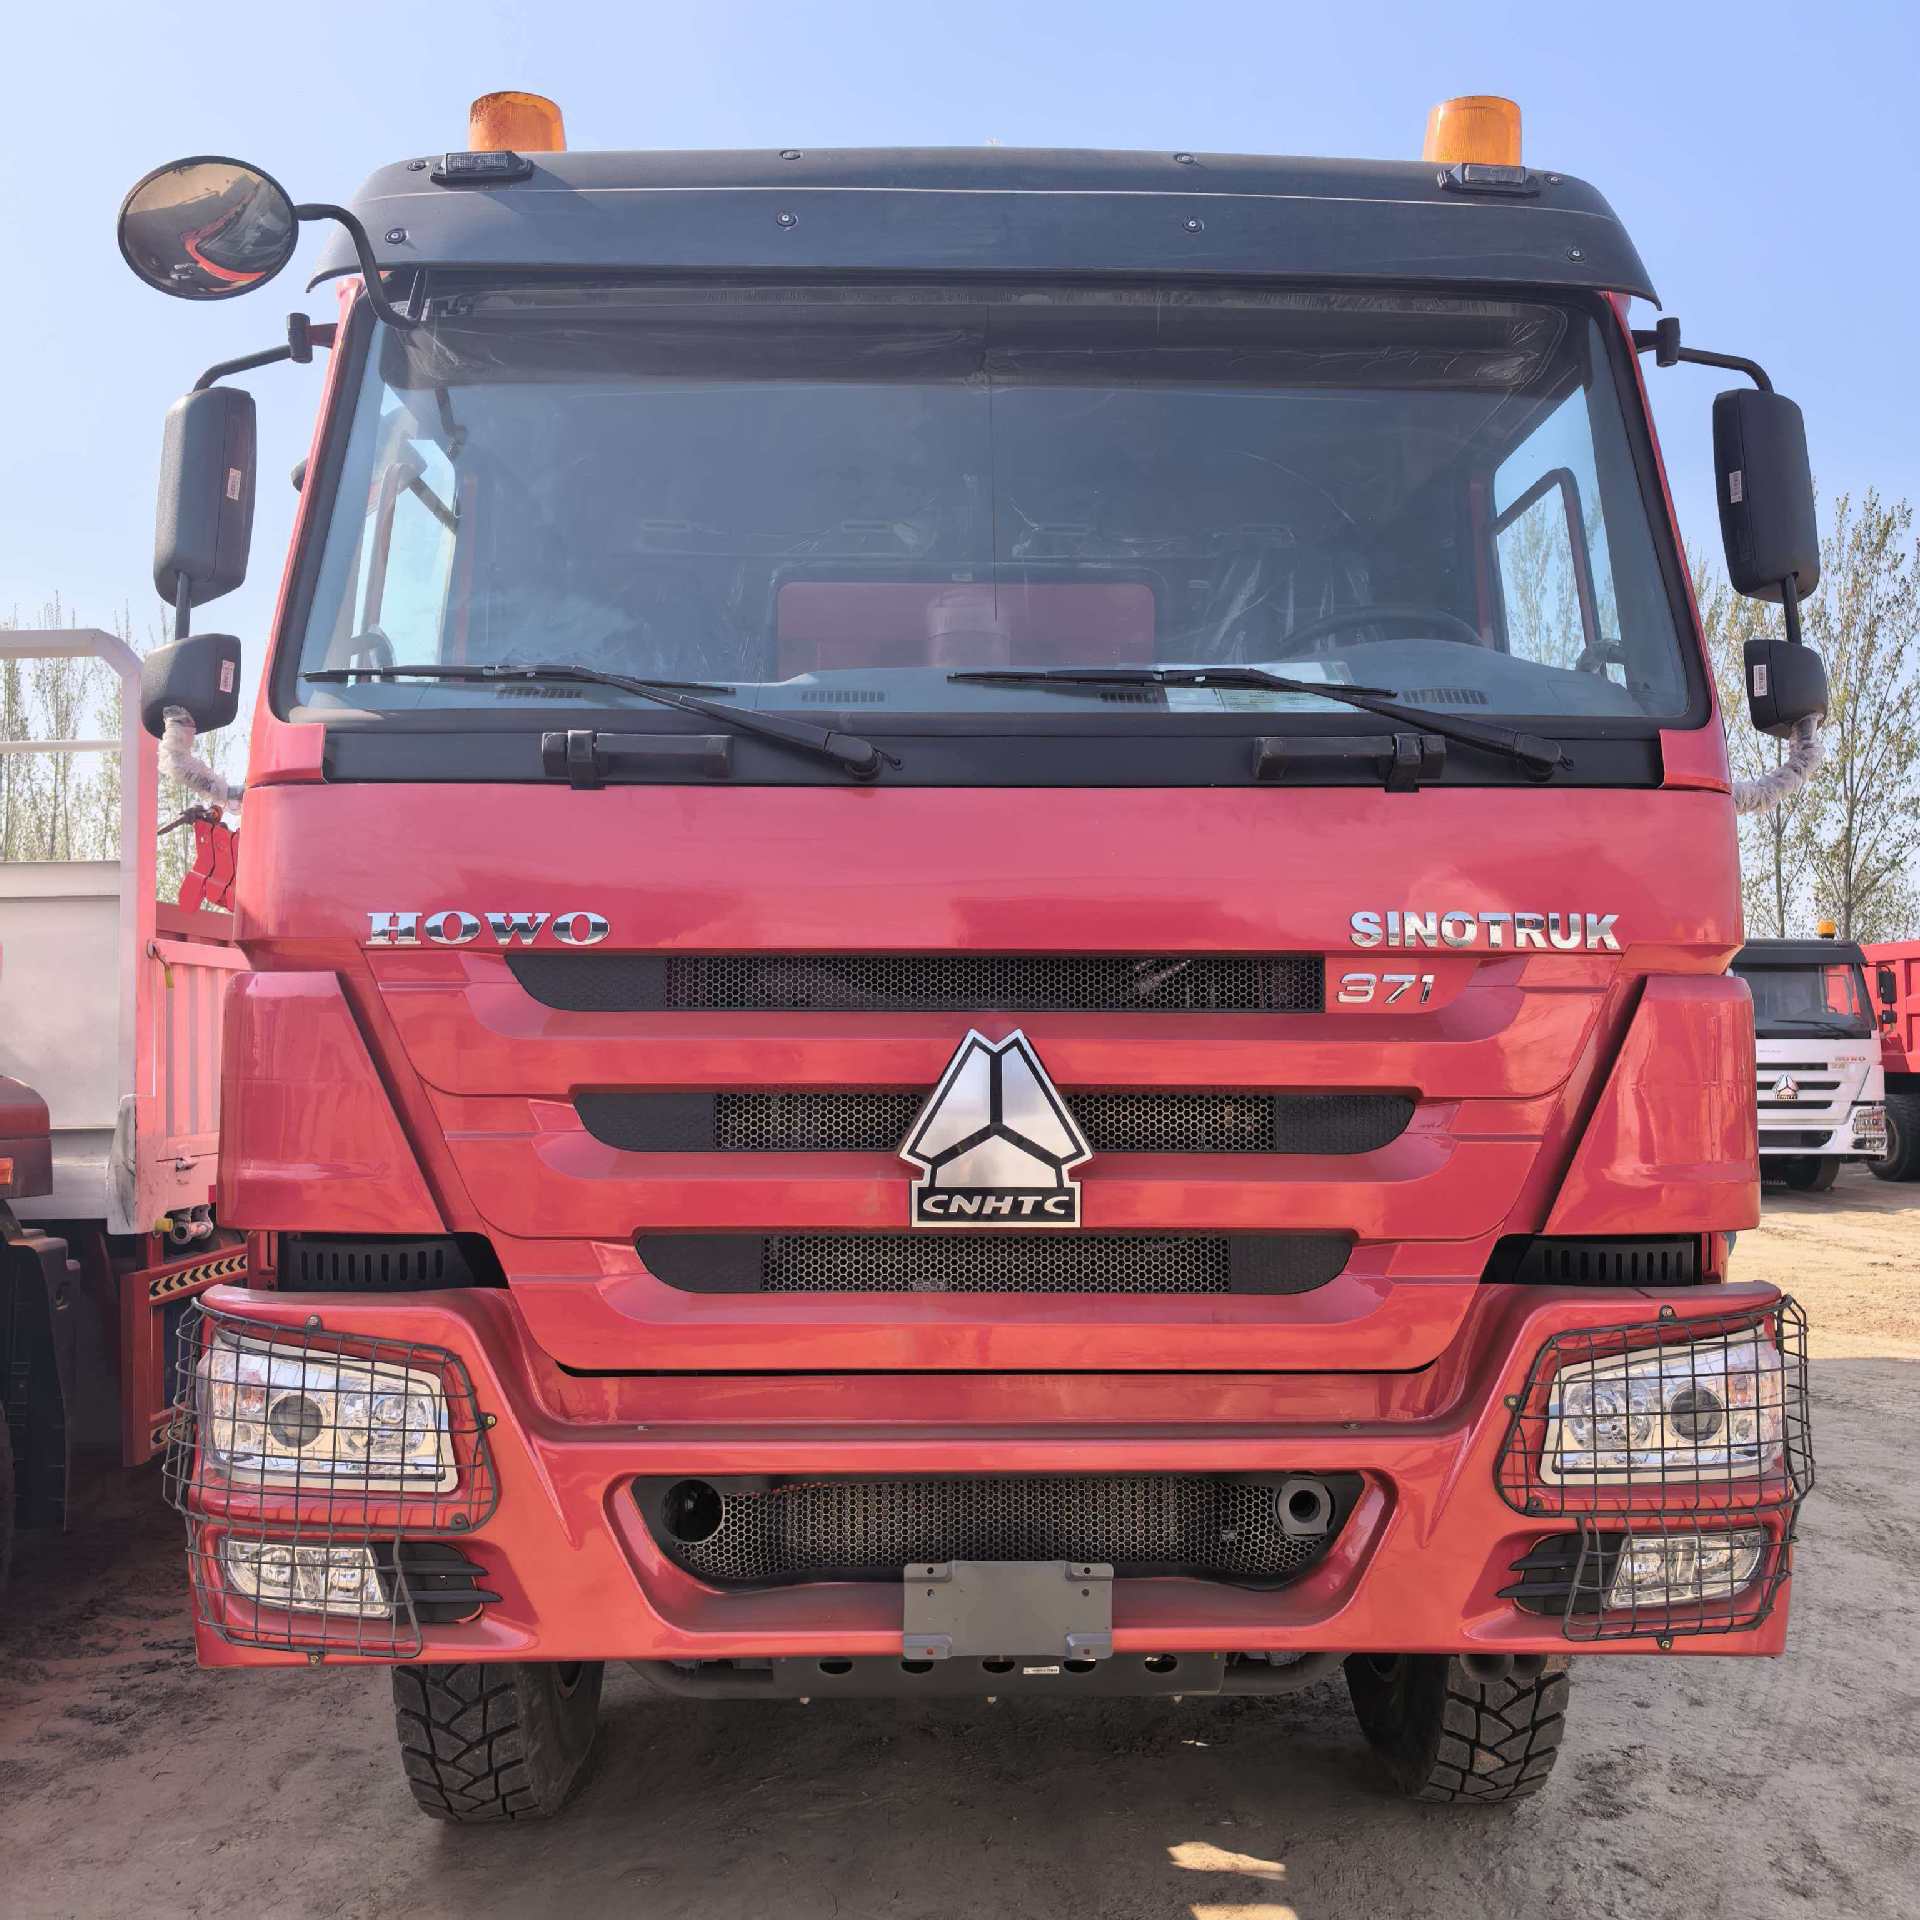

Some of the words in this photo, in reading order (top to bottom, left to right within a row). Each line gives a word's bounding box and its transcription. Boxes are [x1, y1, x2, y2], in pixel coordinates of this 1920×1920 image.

[365, 911, 610, 946] HOWO
[1350, 911, 1620, 949] SINOTRUK
[1337, 973, 1435, 1004] 371
[922, 1194, 1070, 1215] CNHTC
